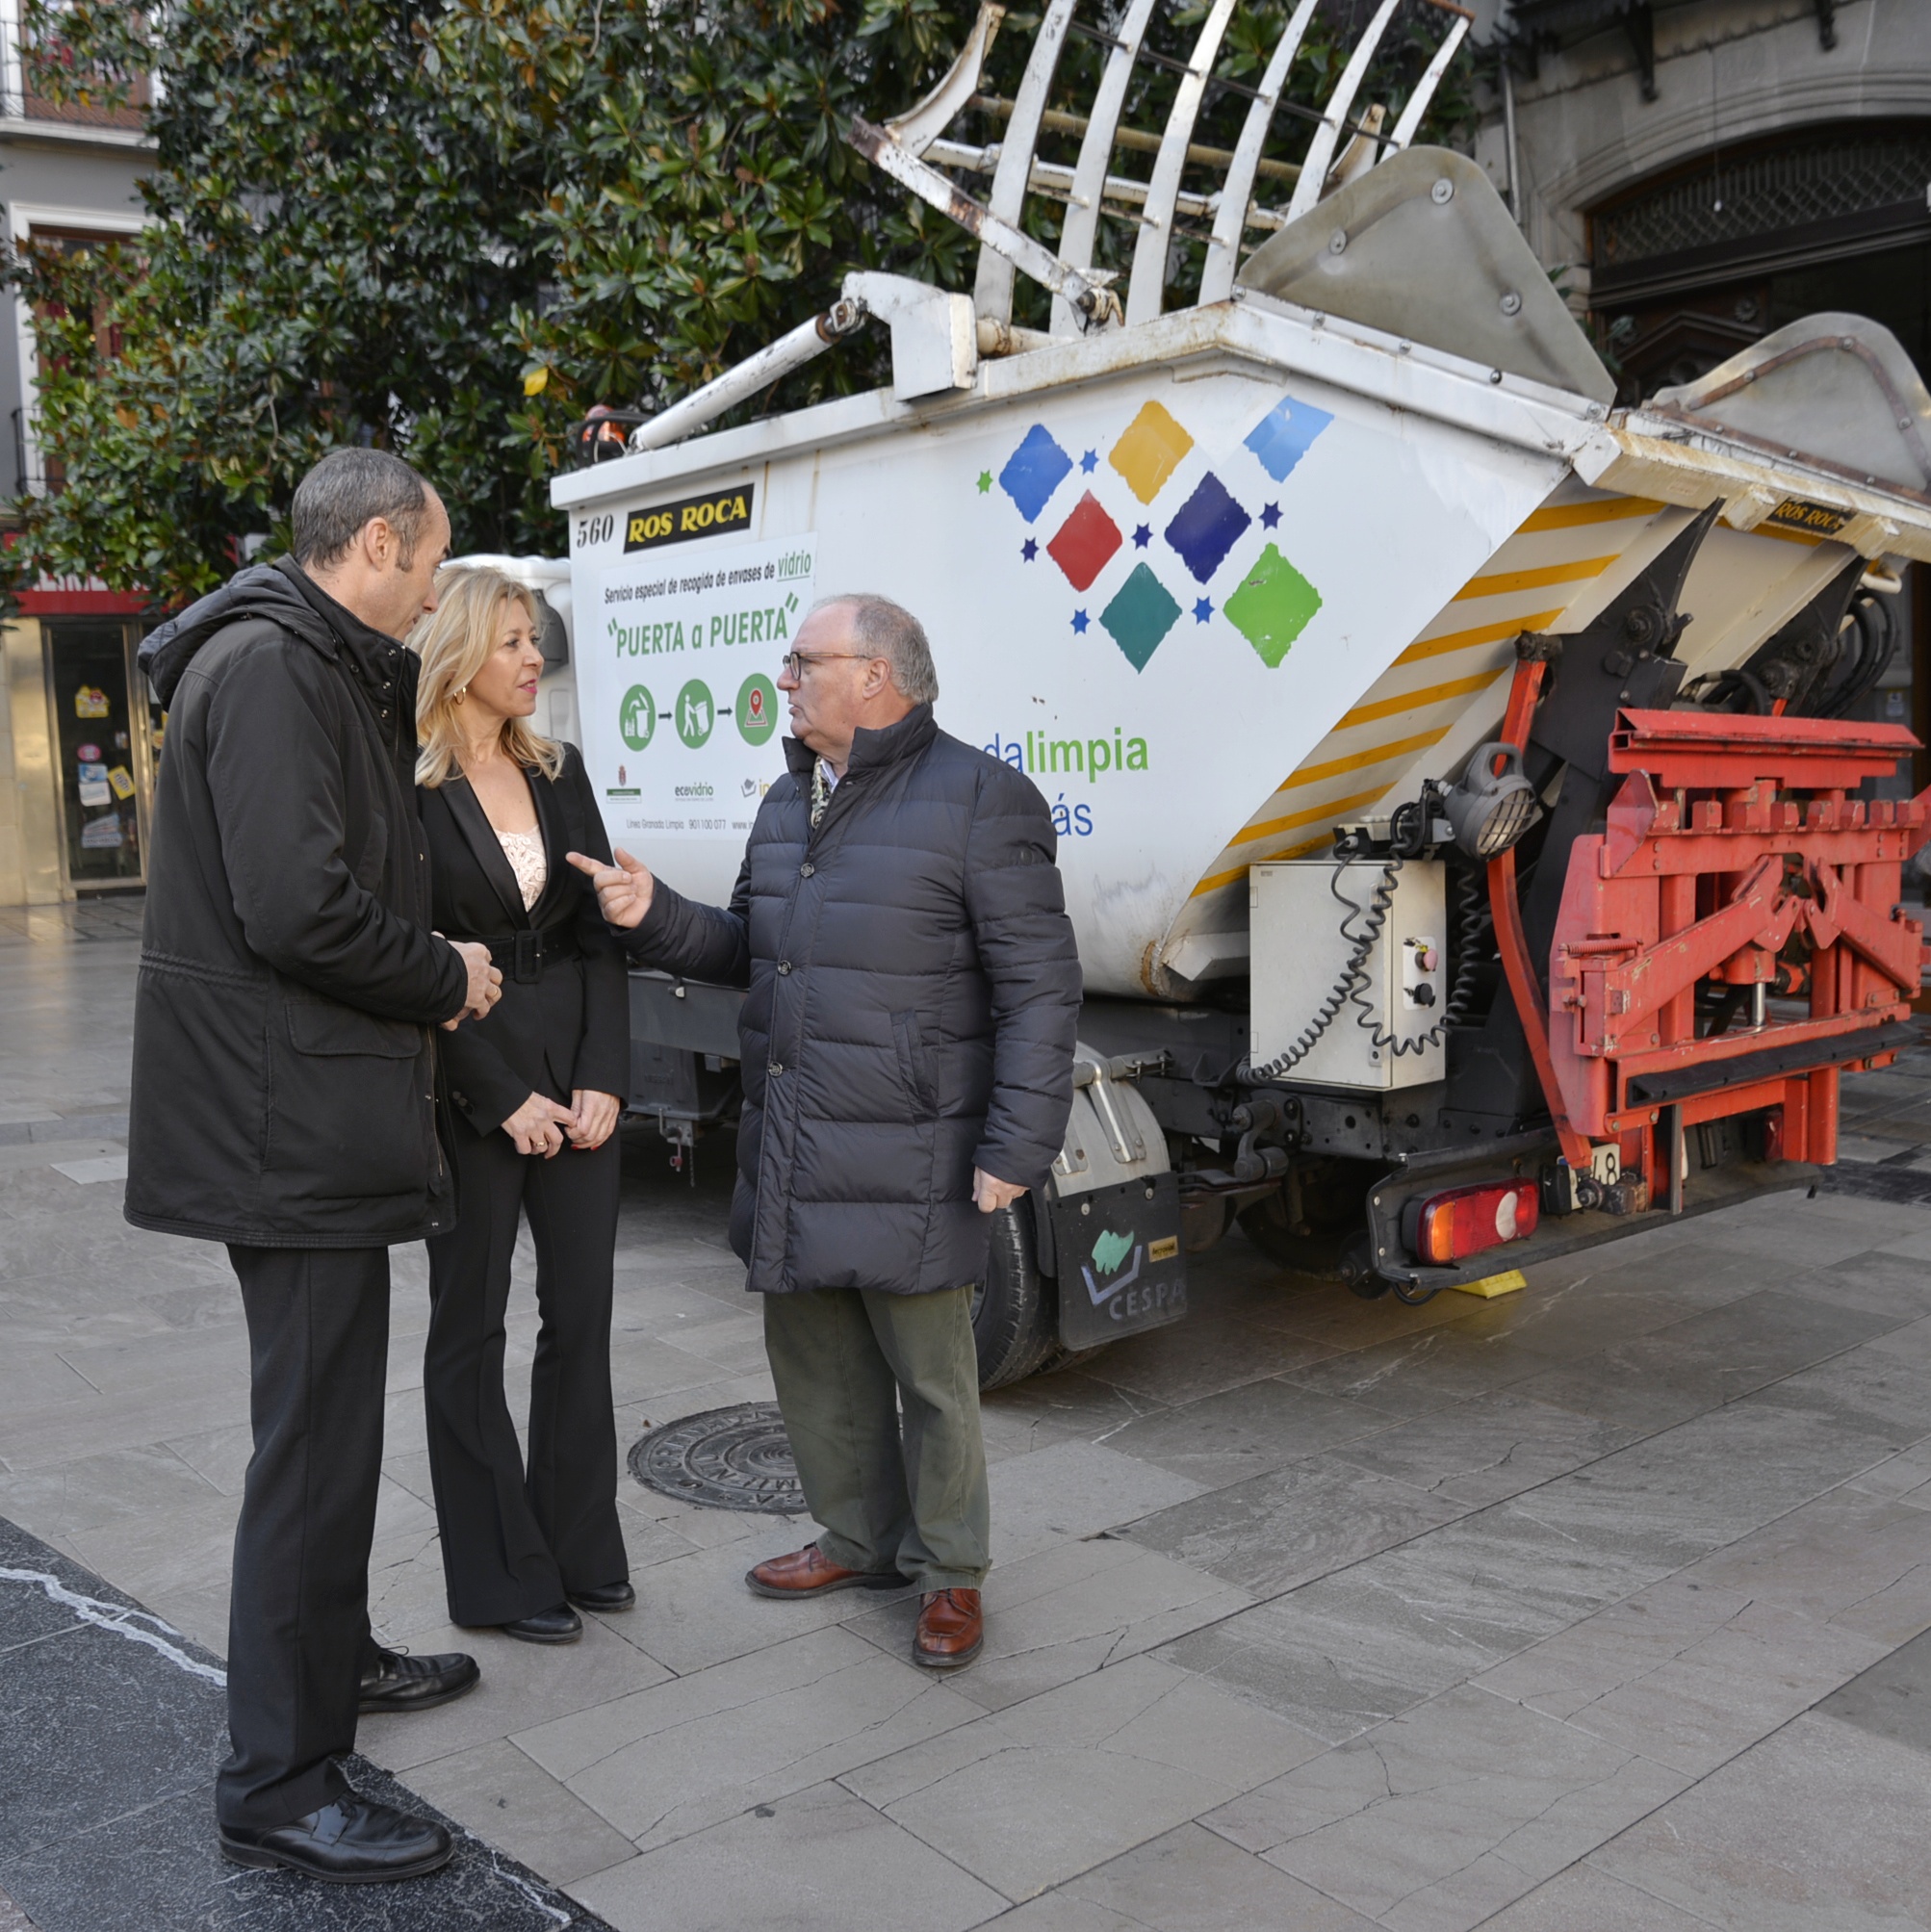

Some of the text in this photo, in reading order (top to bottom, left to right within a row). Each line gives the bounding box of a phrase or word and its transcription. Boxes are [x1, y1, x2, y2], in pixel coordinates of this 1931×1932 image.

[577, 514, 614, 548] 560
[628, 495, 747, 543] ROS ROCA
[1775, 502, 1809, 519] ROS
[605, 549, 811, 605] Servicio especial de recogida de envases de vidrio
[691, 625, 703, 650] a
[1050, 792, 1094, 837] ás
[1109, 1278, 1186, 1321] CESPA
